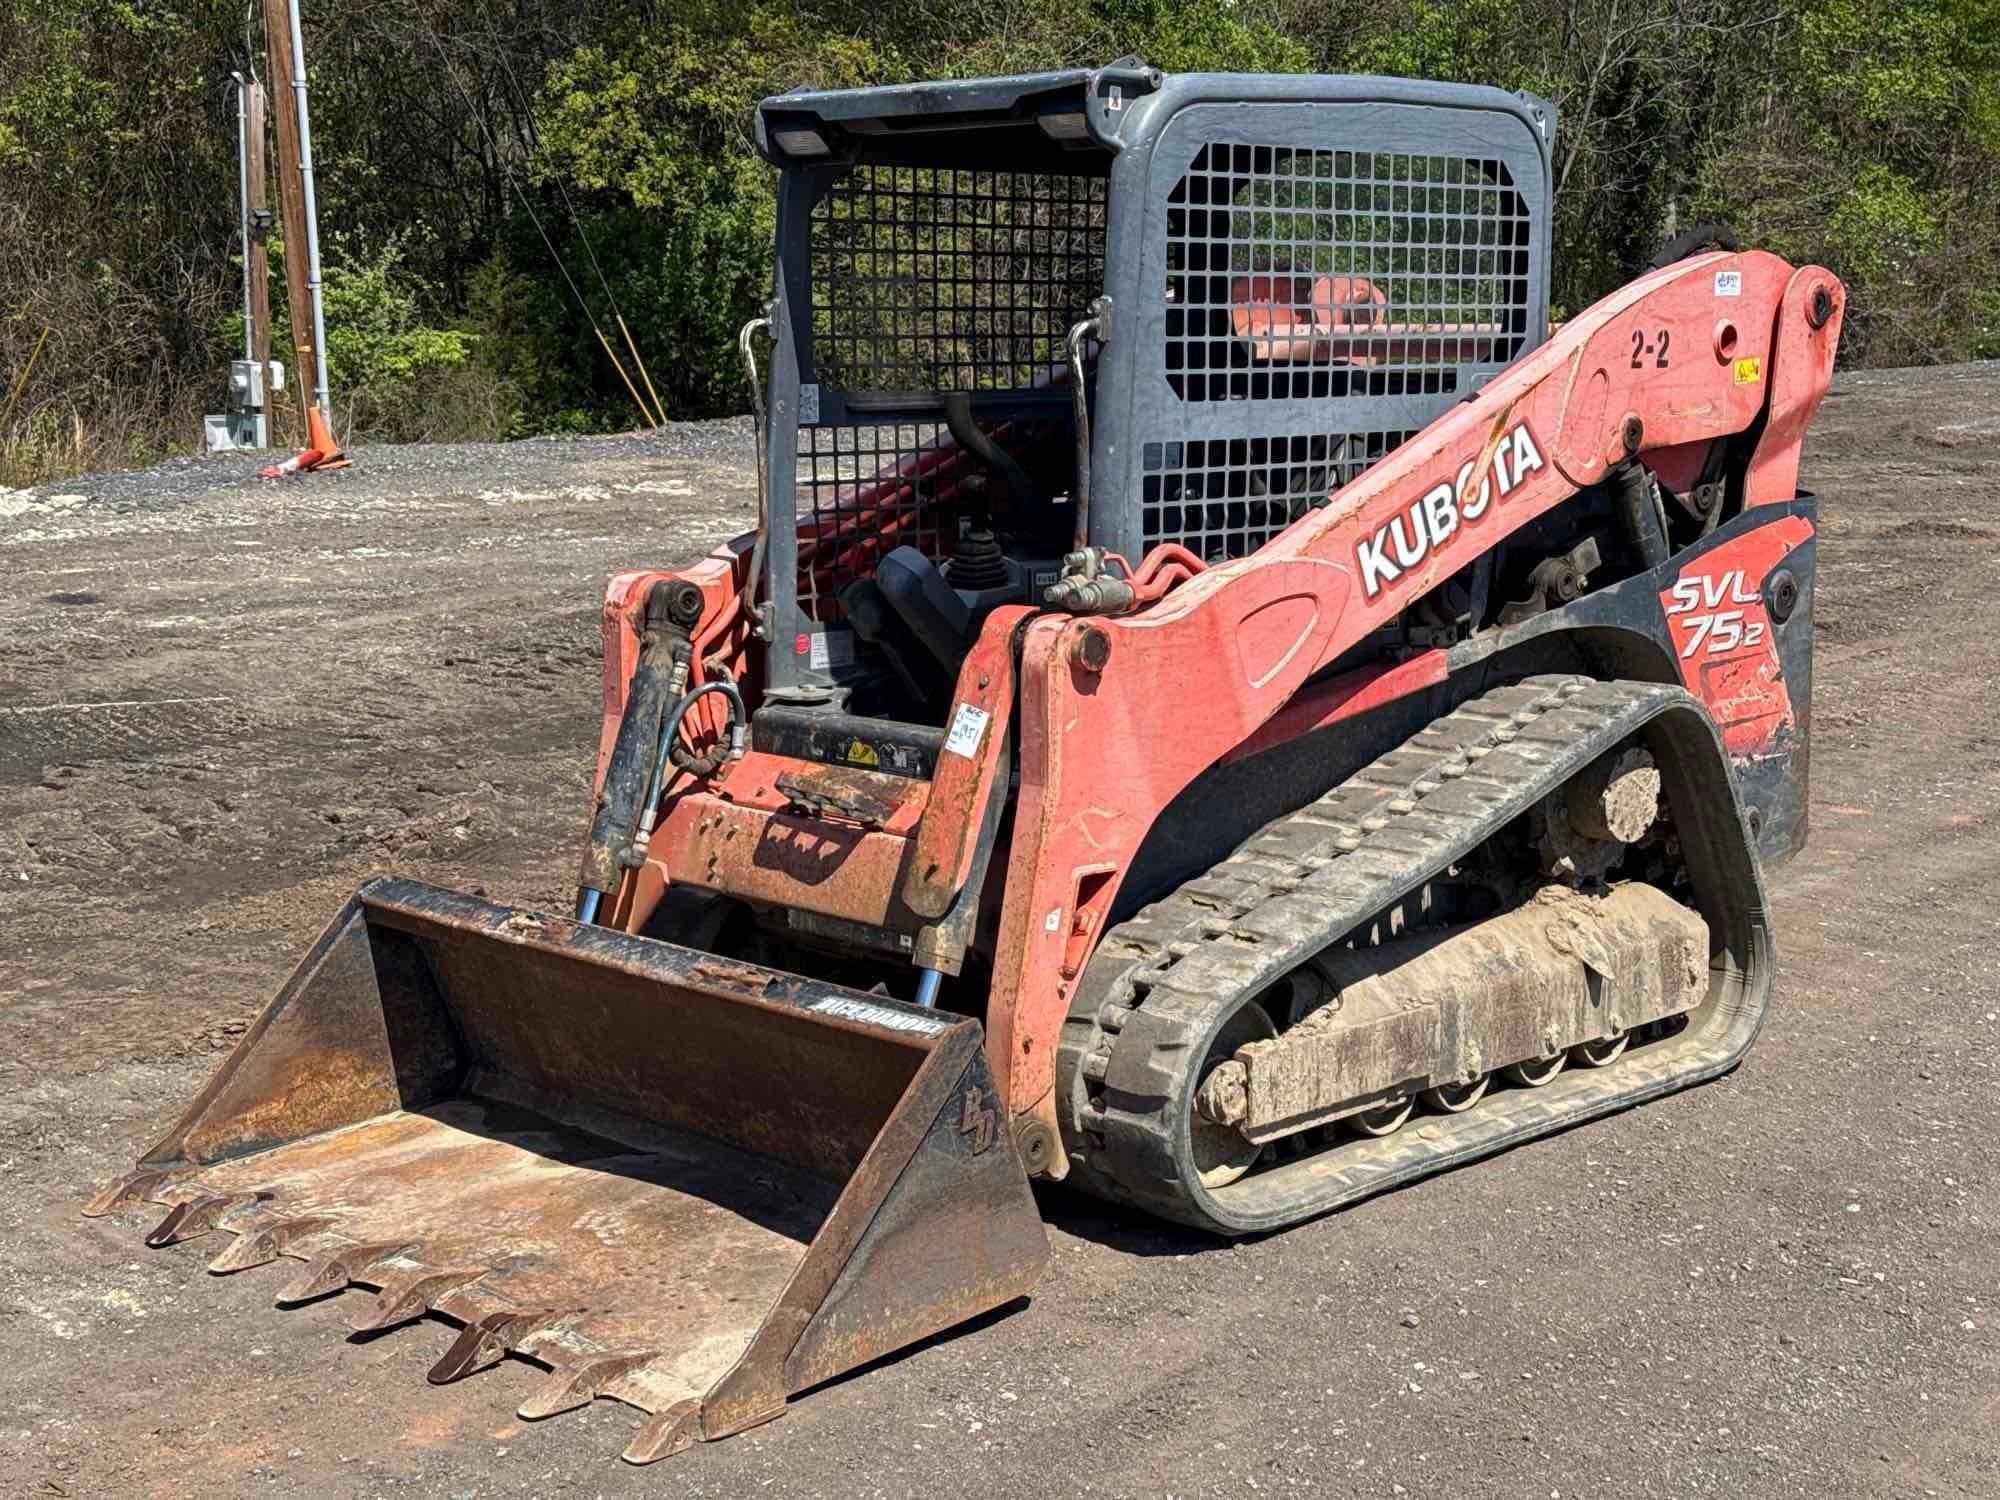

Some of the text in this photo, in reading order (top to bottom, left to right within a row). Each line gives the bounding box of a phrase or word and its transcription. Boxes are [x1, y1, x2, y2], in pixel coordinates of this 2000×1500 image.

[1631, 330, 1670, 369] 2-2
[1357, 424, 1544, 597] KUBOTA
[1667, 570, 1761, 614] SVL
